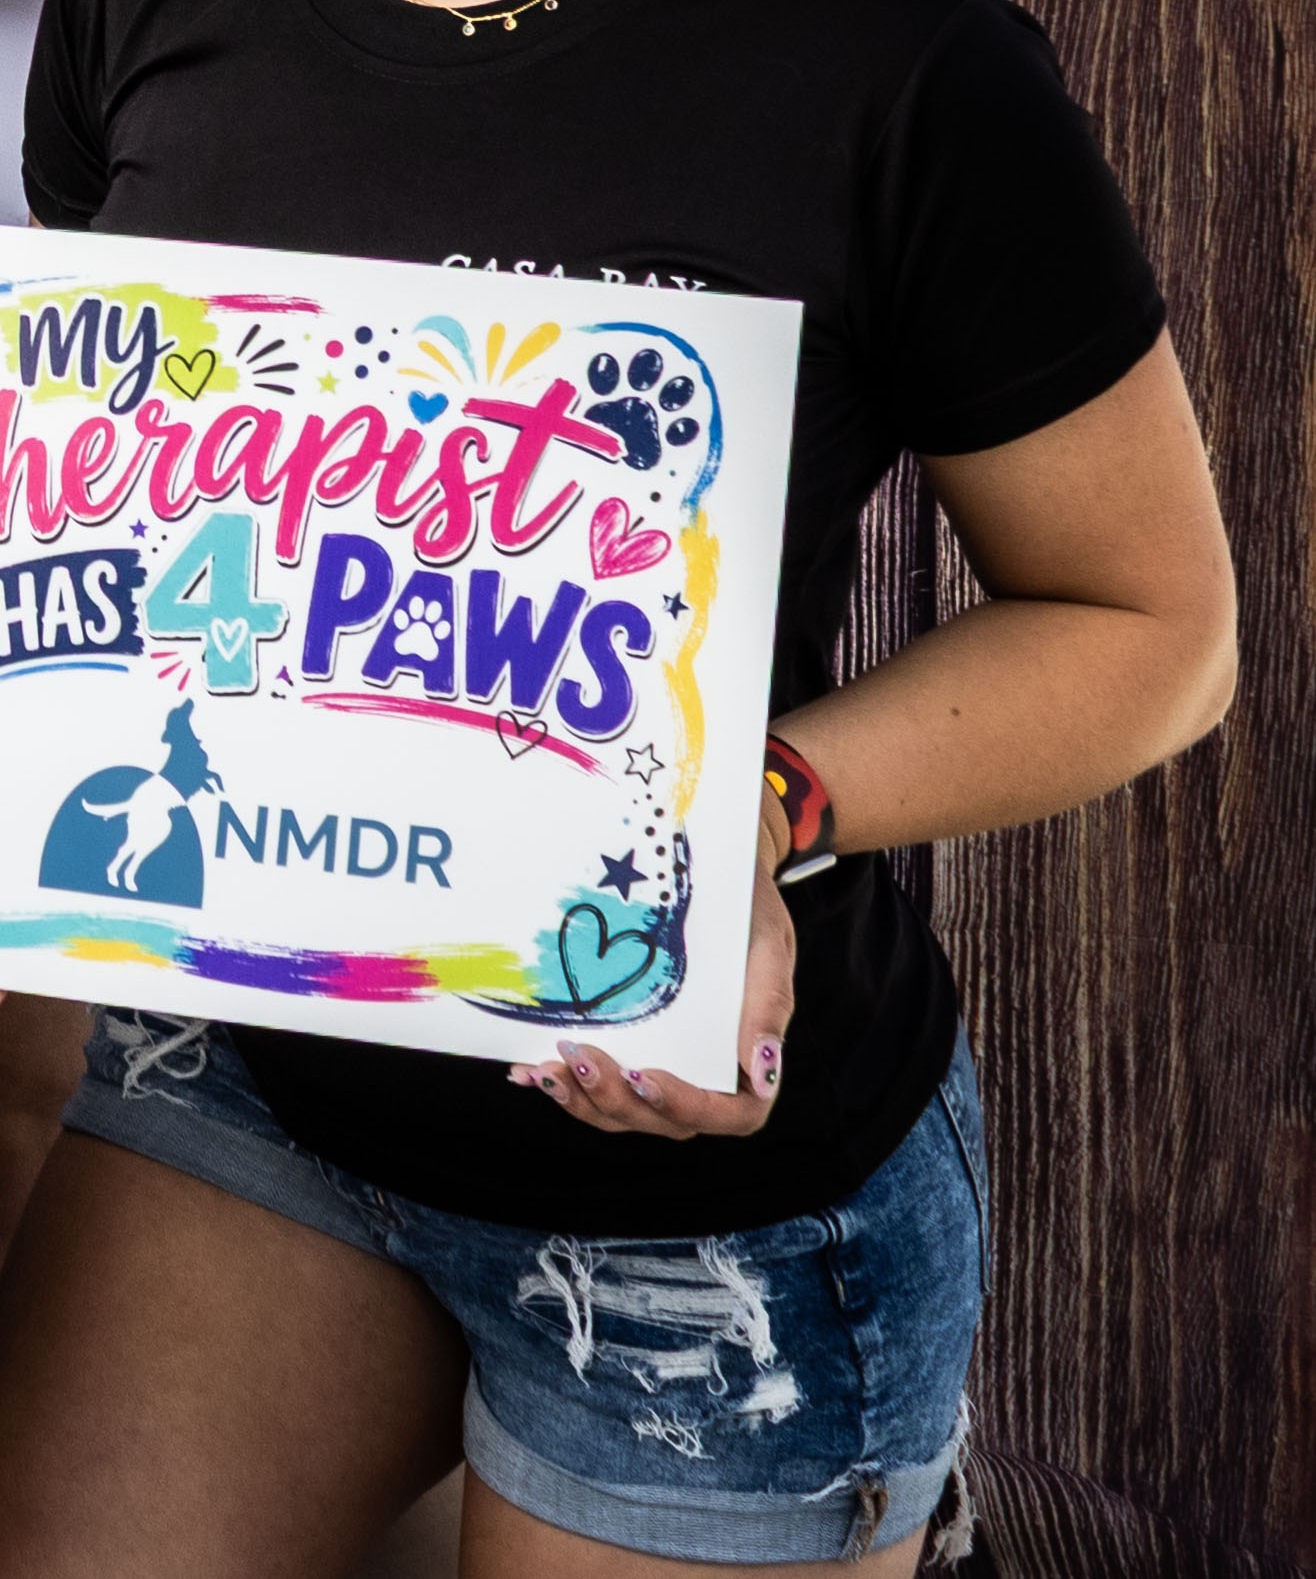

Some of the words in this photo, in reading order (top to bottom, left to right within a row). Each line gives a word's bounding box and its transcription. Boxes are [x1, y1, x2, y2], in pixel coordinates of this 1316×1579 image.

[145, 513, 284, 691] 4
[301, 533, 652, 734] PAWS
[214, 800, 453, 889] NMDR
